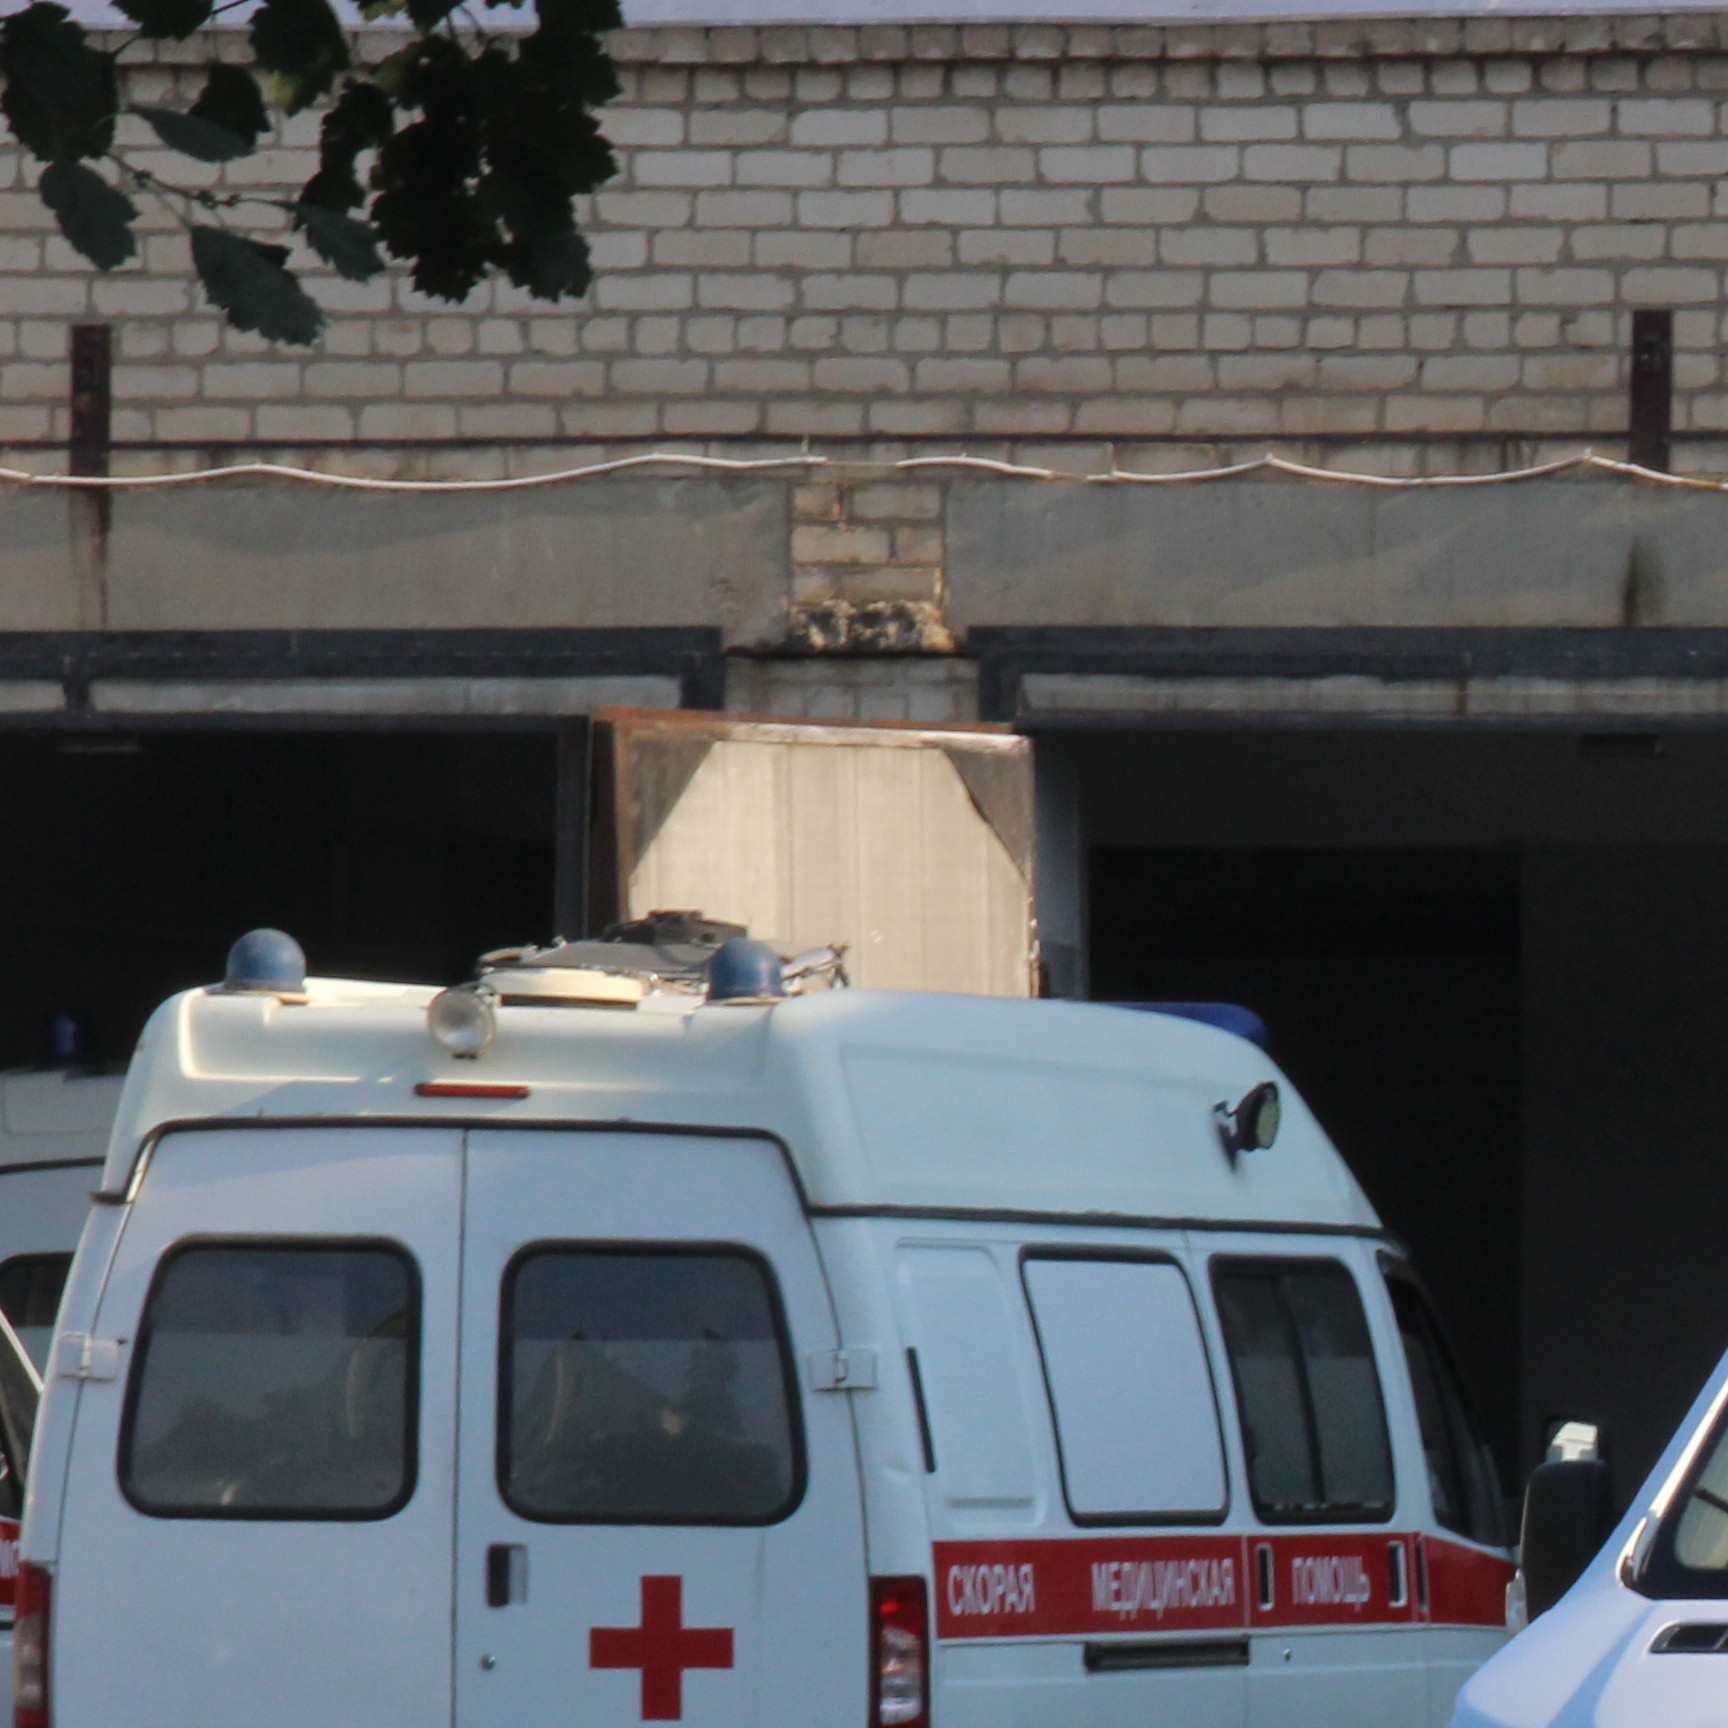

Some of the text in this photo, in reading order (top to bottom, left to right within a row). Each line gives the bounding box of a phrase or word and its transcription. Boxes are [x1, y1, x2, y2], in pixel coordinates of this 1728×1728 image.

[946, 1556, 1372, 1621] СКОРАЯ МЕДИЦИНСКАЯ ПОМОЩЬ
